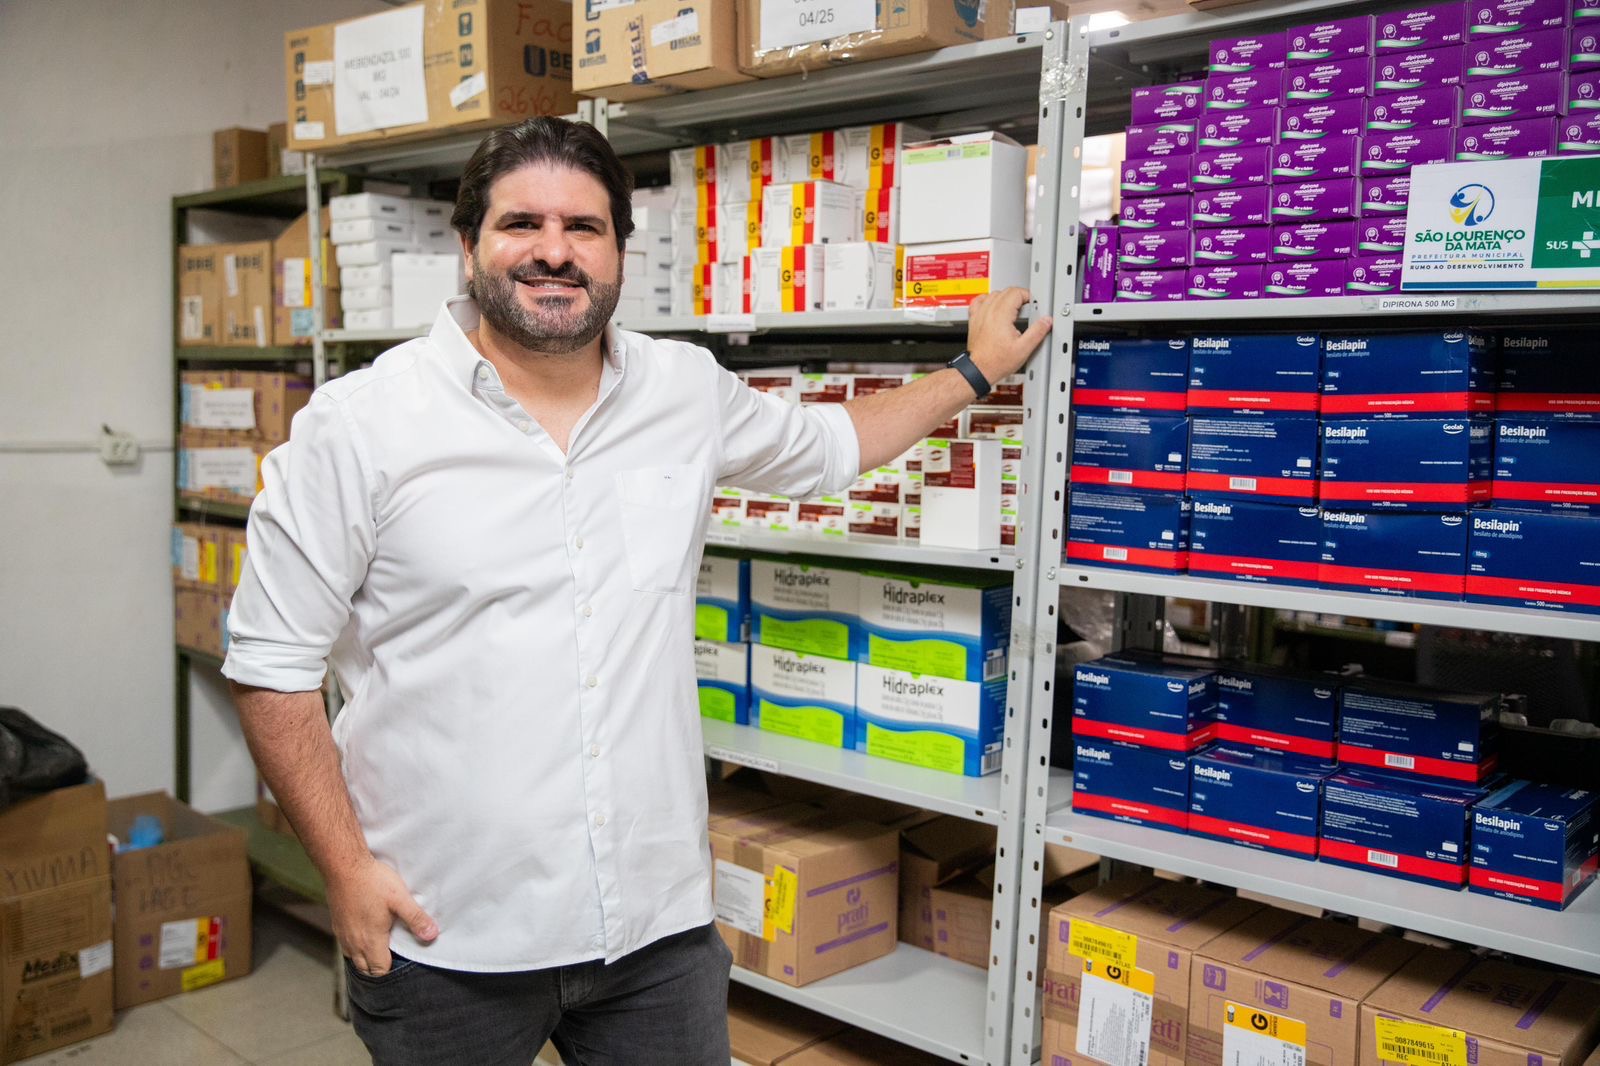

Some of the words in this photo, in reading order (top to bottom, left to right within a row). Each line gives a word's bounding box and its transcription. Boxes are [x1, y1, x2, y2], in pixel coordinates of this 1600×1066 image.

[799, 8, 834, 27] 04/25
[871, 148, 880, 160] G
[751, 162, 759, 172] G
[812, 156, 820, 167] G
[794, 207, 801, 218] G
[866, 212, 875, 223] G
[1415, 230, 1443, 242] SÃO
[1446, 230, 1525, 243] LOURENÇO
[1445, 242, 1463, 251] DA
[1466, 241, 1502, 250] MATA
[1546, 240, 1568, 250] SUS
[782, 270, 791, 281] G
[895, 269, 903, 281] G
[914, 282, 922, 294] G
[1079, 341, 1110, 352] Besilapin
[1193, 338, 1229, 350] Besilapin
[1326, 340, 1367, 351] Besilapin
[1504, 337, 1548, 349] Besilapin
[1326, 427, 1366, 439] Besilapin
[1500, 426, 1546, 438] Besilapin
[1195, 502, 1230, 515] Besilapin
[1324, 511, 1365, 524] Besilapin
[1474, 518, 1519, 532] Besilapin
[774, 569, 830, 587] Hidraplex
[883, 584, 945, 605] Hidraplex
[774, 655, 825, 674] Hidraplex
[1077, 671, 1109, 685] Besilapin
[1219, 676, 1251, 690] Besilapin
[883, 675, 943, 696] Hidraplex
[1077, 746, 1110, 760] Besilapin
[1194, 765, 1230, 780] Besilapin
[1476, 813, 1520, 831] Besilapin
[1106, 965, 1121, 979] G
[1251, 1013, 1268, 1030] G
[1152, 1018, 1181, 1042] ati
[1395, 1036, 1434, 1050] 0087849615
